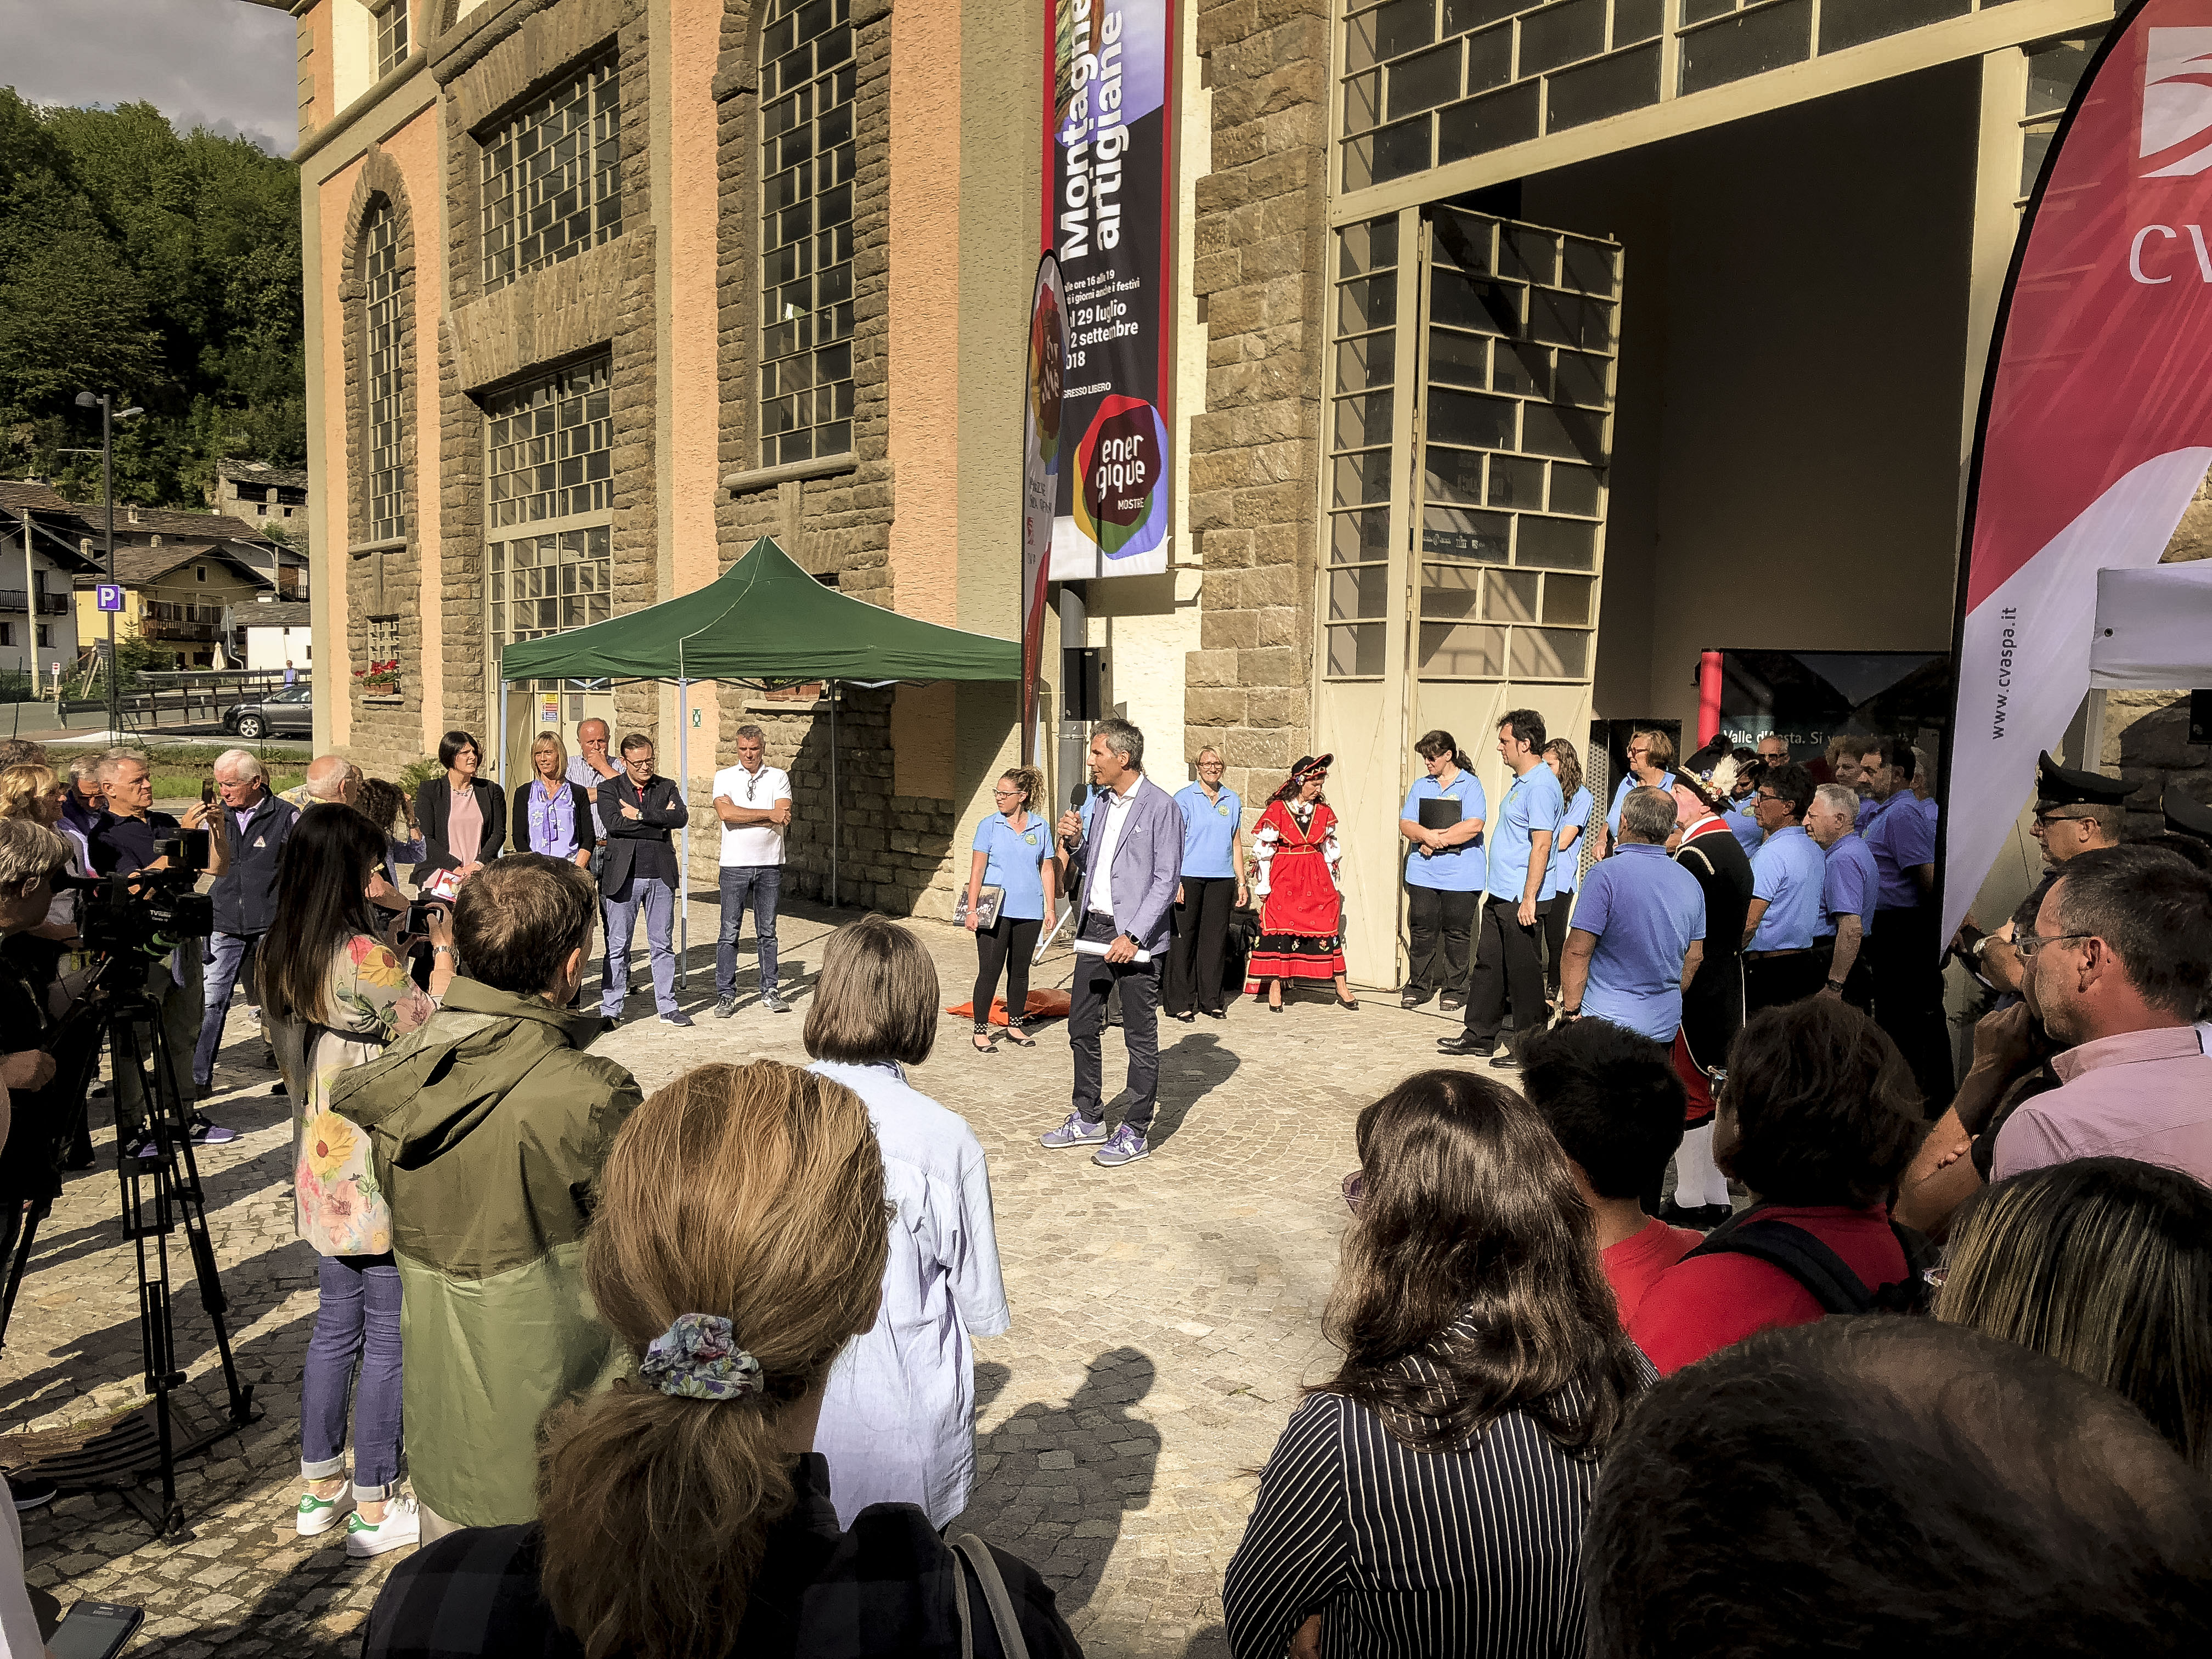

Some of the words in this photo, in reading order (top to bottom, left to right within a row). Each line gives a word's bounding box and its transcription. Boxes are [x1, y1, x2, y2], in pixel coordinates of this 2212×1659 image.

[1060, 0, 1099, 262] Montagne
[1090, 10, 1130, 251] artigiane
[1074, 280, 1086, 290] ore
[1087, 275, 1096, 286] 16
[1106, 269, 1115, 280] 19
[1116, 276, 1140, 291] festivi
[1077, 307, 1093, 326] 29
[1096, 299, 1127, 323] luglio
[1070, 332, 1077, 348] 2
[1079, 320, 1139, 346] settembre
[1066, 351, 1086, 370] 018
[1063, 386, 1087, 398] GRESSO
[1088, 382, 1111, 394] LIBERO
[1102, 435, 1144, 463] ener
[1096, 460, 1146, 502] gique
[1118, 497, 1144, 510] MOSTRE
[100, 588, 115, 607] P
[1992, 607, 2017, 740] www.cvaspa.it
[1723, 730, 1752, 743] Valle
[1810, 731, 1823, 745] Si
